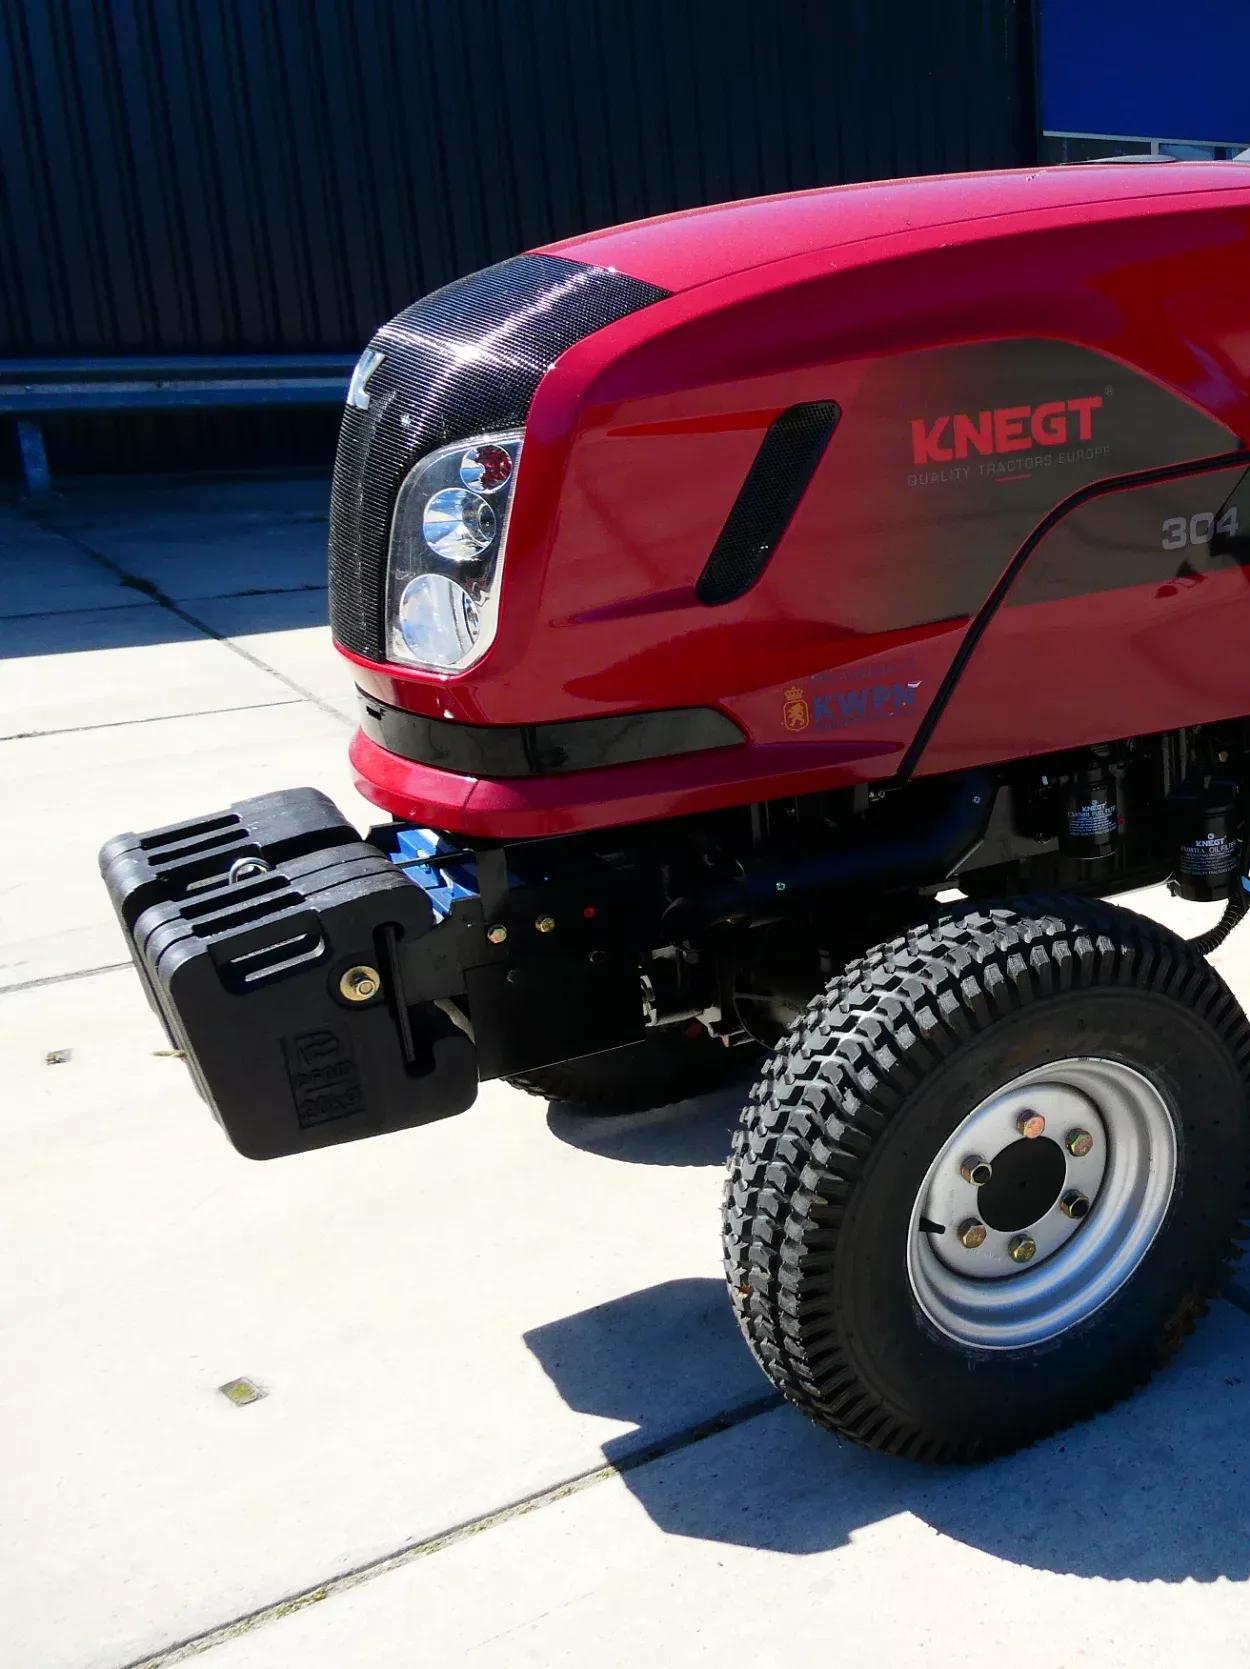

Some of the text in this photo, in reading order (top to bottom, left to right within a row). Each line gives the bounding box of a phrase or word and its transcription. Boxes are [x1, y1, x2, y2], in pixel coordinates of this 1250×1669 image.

[911, 396, 1103, 465] KNEGT
[907, 445, 1112, 488] QUALITY TRACTORS EUROPE
[1162, 506, 1239, 551] 304
[813, 682, 916, 721] KWPN
[1195, 837, 1225, 847] KNEGT
